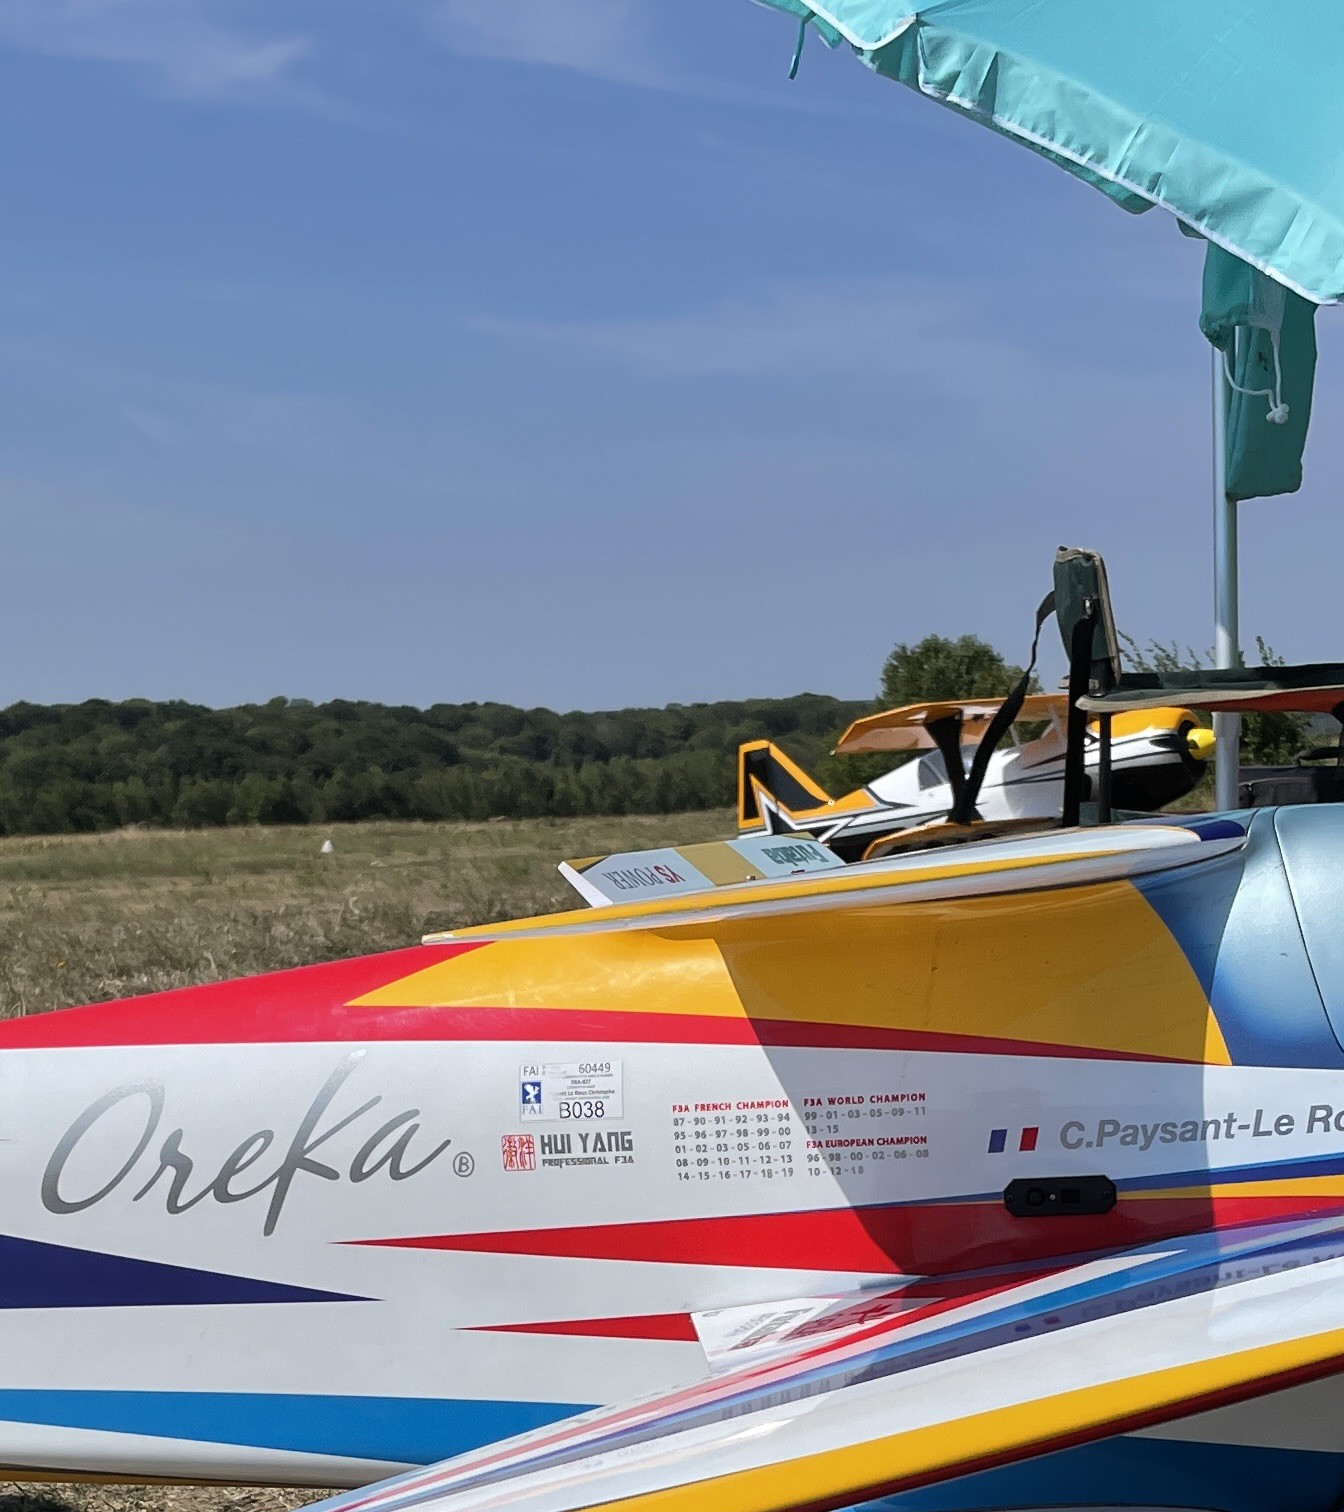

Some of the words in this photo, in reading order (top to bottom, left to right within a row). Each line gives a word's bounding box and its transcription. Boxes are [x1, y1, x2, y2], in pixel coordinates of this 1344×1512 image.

[761, 844, 829, 867] Futaba
[602, 866, 657, 890] POWER
[578, 1062, 611, 1074] 60449
[804, 1098, 822, 1106] F3A
[828, 1096, 864, 1105] WORLD
[870, 1093, 925, 1103] CHAMPION
[522, 1105, 542, 1114] FAI
[559, 1101, 604, 1119] B038
[672, 1105, 689, 1113] F3A
[695, 1103, 731, 1112] FRENCH
[737, 1100, 788, 1110] CHAMPION
[40, 1047, 452, 1236] Oreka
[540, 1133, 572, 1155] HUI
[578, 1131, 633, 1152] YANG
[807, 1141, 823, 1149] F3A
[826, 1139, 874, 1148] EUROPEAN
[877, 1136, 927, 1145] CHAMPION
[541, 1157, 609, 1168] PROFESSIONAL
[614, 1155, 634, 1164] F3A
